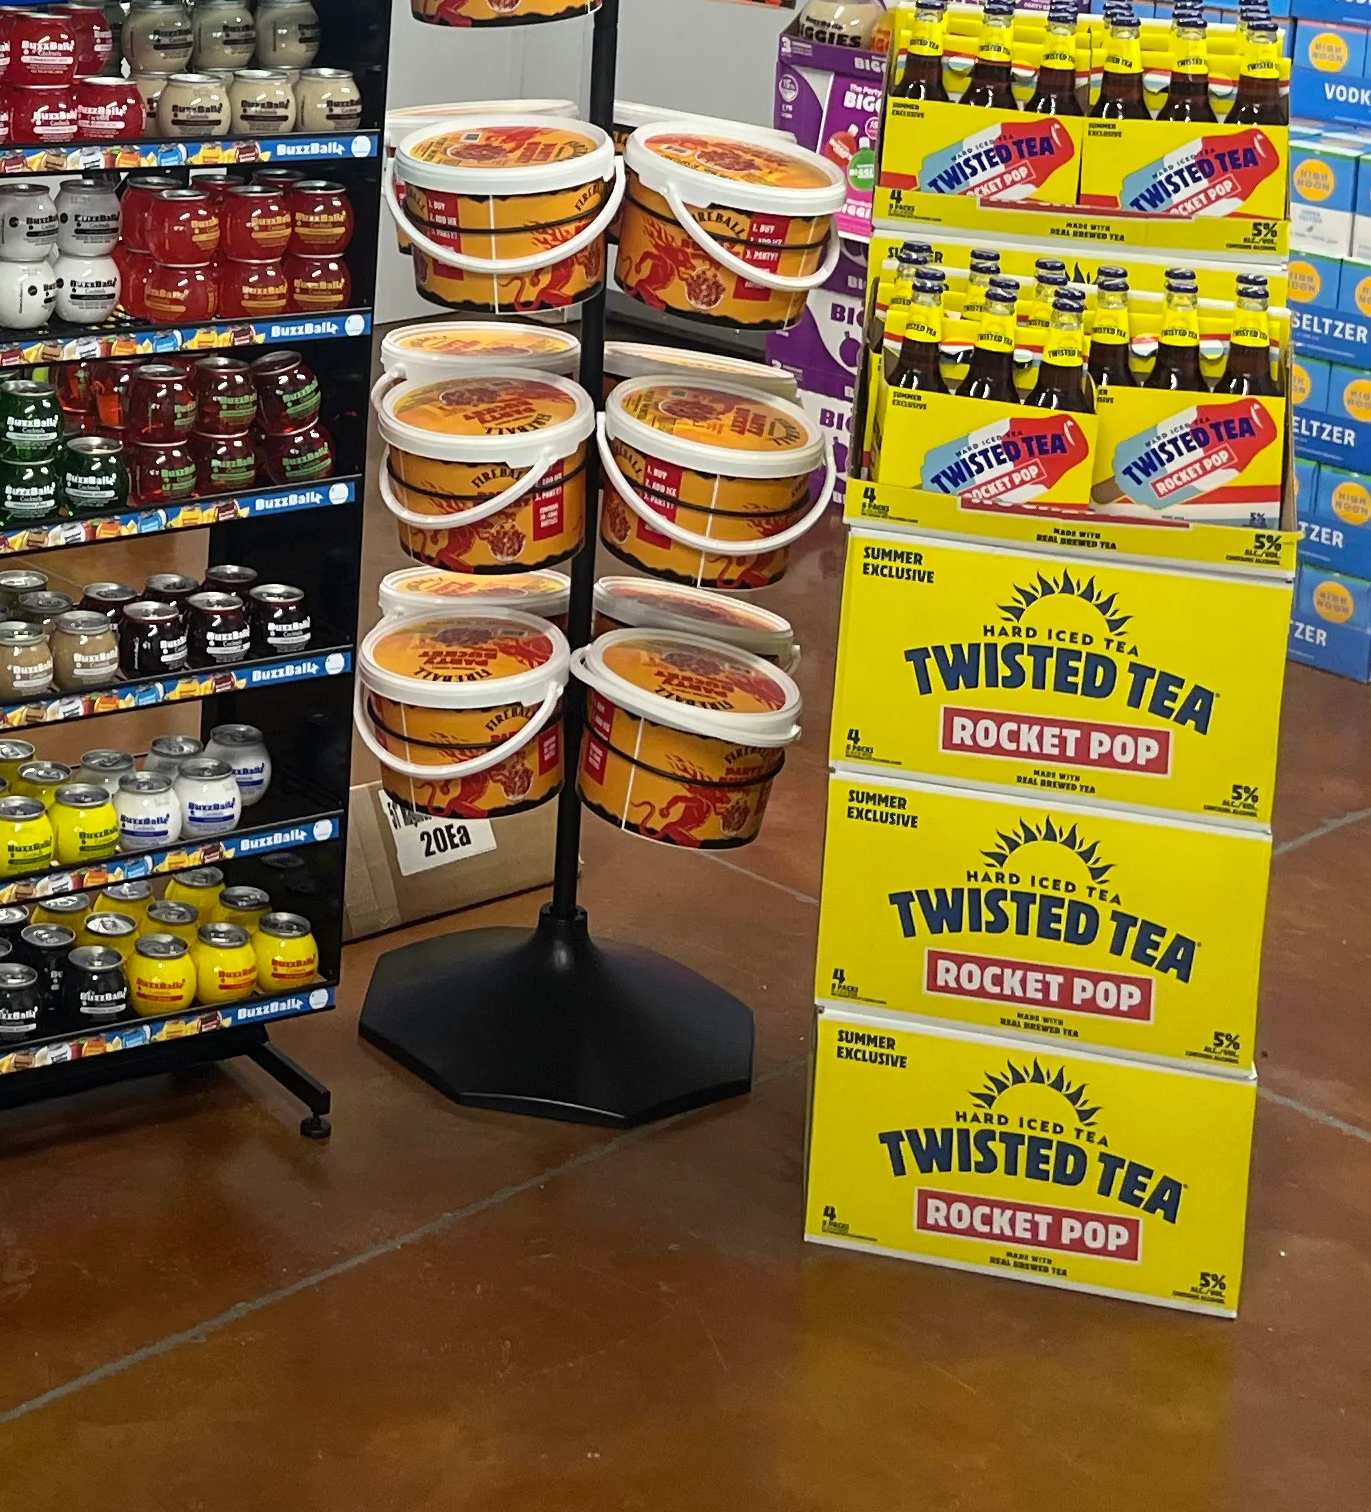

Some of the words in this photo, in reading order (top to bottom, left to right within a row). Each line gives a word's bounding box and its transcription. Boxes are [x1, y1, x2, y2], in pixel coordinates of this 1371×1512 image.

[928, 142, 1013, 196] TWISTED
[1013, 134, 1056, 159] TEA
[1001, 166, 1029, 189] POP
[1130, 154, 1215, 212] TWISTED
[1216, 147, 1260, 172] TEA
[1204, 180, 1234, 203] POP
[1250, 222, 1278, 239] 5%
[1292, 311, 1368, 344] SELTZER
[931, 439, 1021, 495] TWISTED
[1021, 433, 1068, 458] TEA
[1122, 426, 1211, 486] TWISTED
[1209, 417, 1256, 442] TEA
[1157, 460, 1201, 496] ROCKET
[1195, 450, 1230, 476] POP
[862, 563, 934, 585] EXCLUSIVE
[863, 546, 923, 566] SUMMER
[983, 624, 1037, 639] HARD
[1048, 628, 1095, 646] ICED
[1103, 635, 1140, 657] TEA
[904, 642, 1119, 699] TWISTED
[1127, 662, 1216, 736] TEA
[952, 716, 1081, 760] ROCKET
[1088, 734, 1160, 766] POP
[848, 790, 907, 810] SUMMER
[1231, 784, 1259, 803] 5%
[846, 807, 918, 829] EXCLUSIVE
[420, 820, 471, 858] 20Ea
[966, 869, 1020, 886] HARD
[1030, 875, 1077, 893] ICED
[1086, 885, 1122, 906] TEA
[888, 888, 1100, 946] TWISTED
[1108, 906, 1196, 984] TEA
[936, 959, 1065, 1002] ROCKET
[1072, 977, 1142, 1011] POP
[1212, 1031, 1240, 1050] 5%
[878, 1127, 1087, 1186] TWISTED
[1096, 1147, 1184, 1225] TEA
[926, 1197, 1053, 1240] ROCKET
[1060, 1217, 1129, 1251] POP
